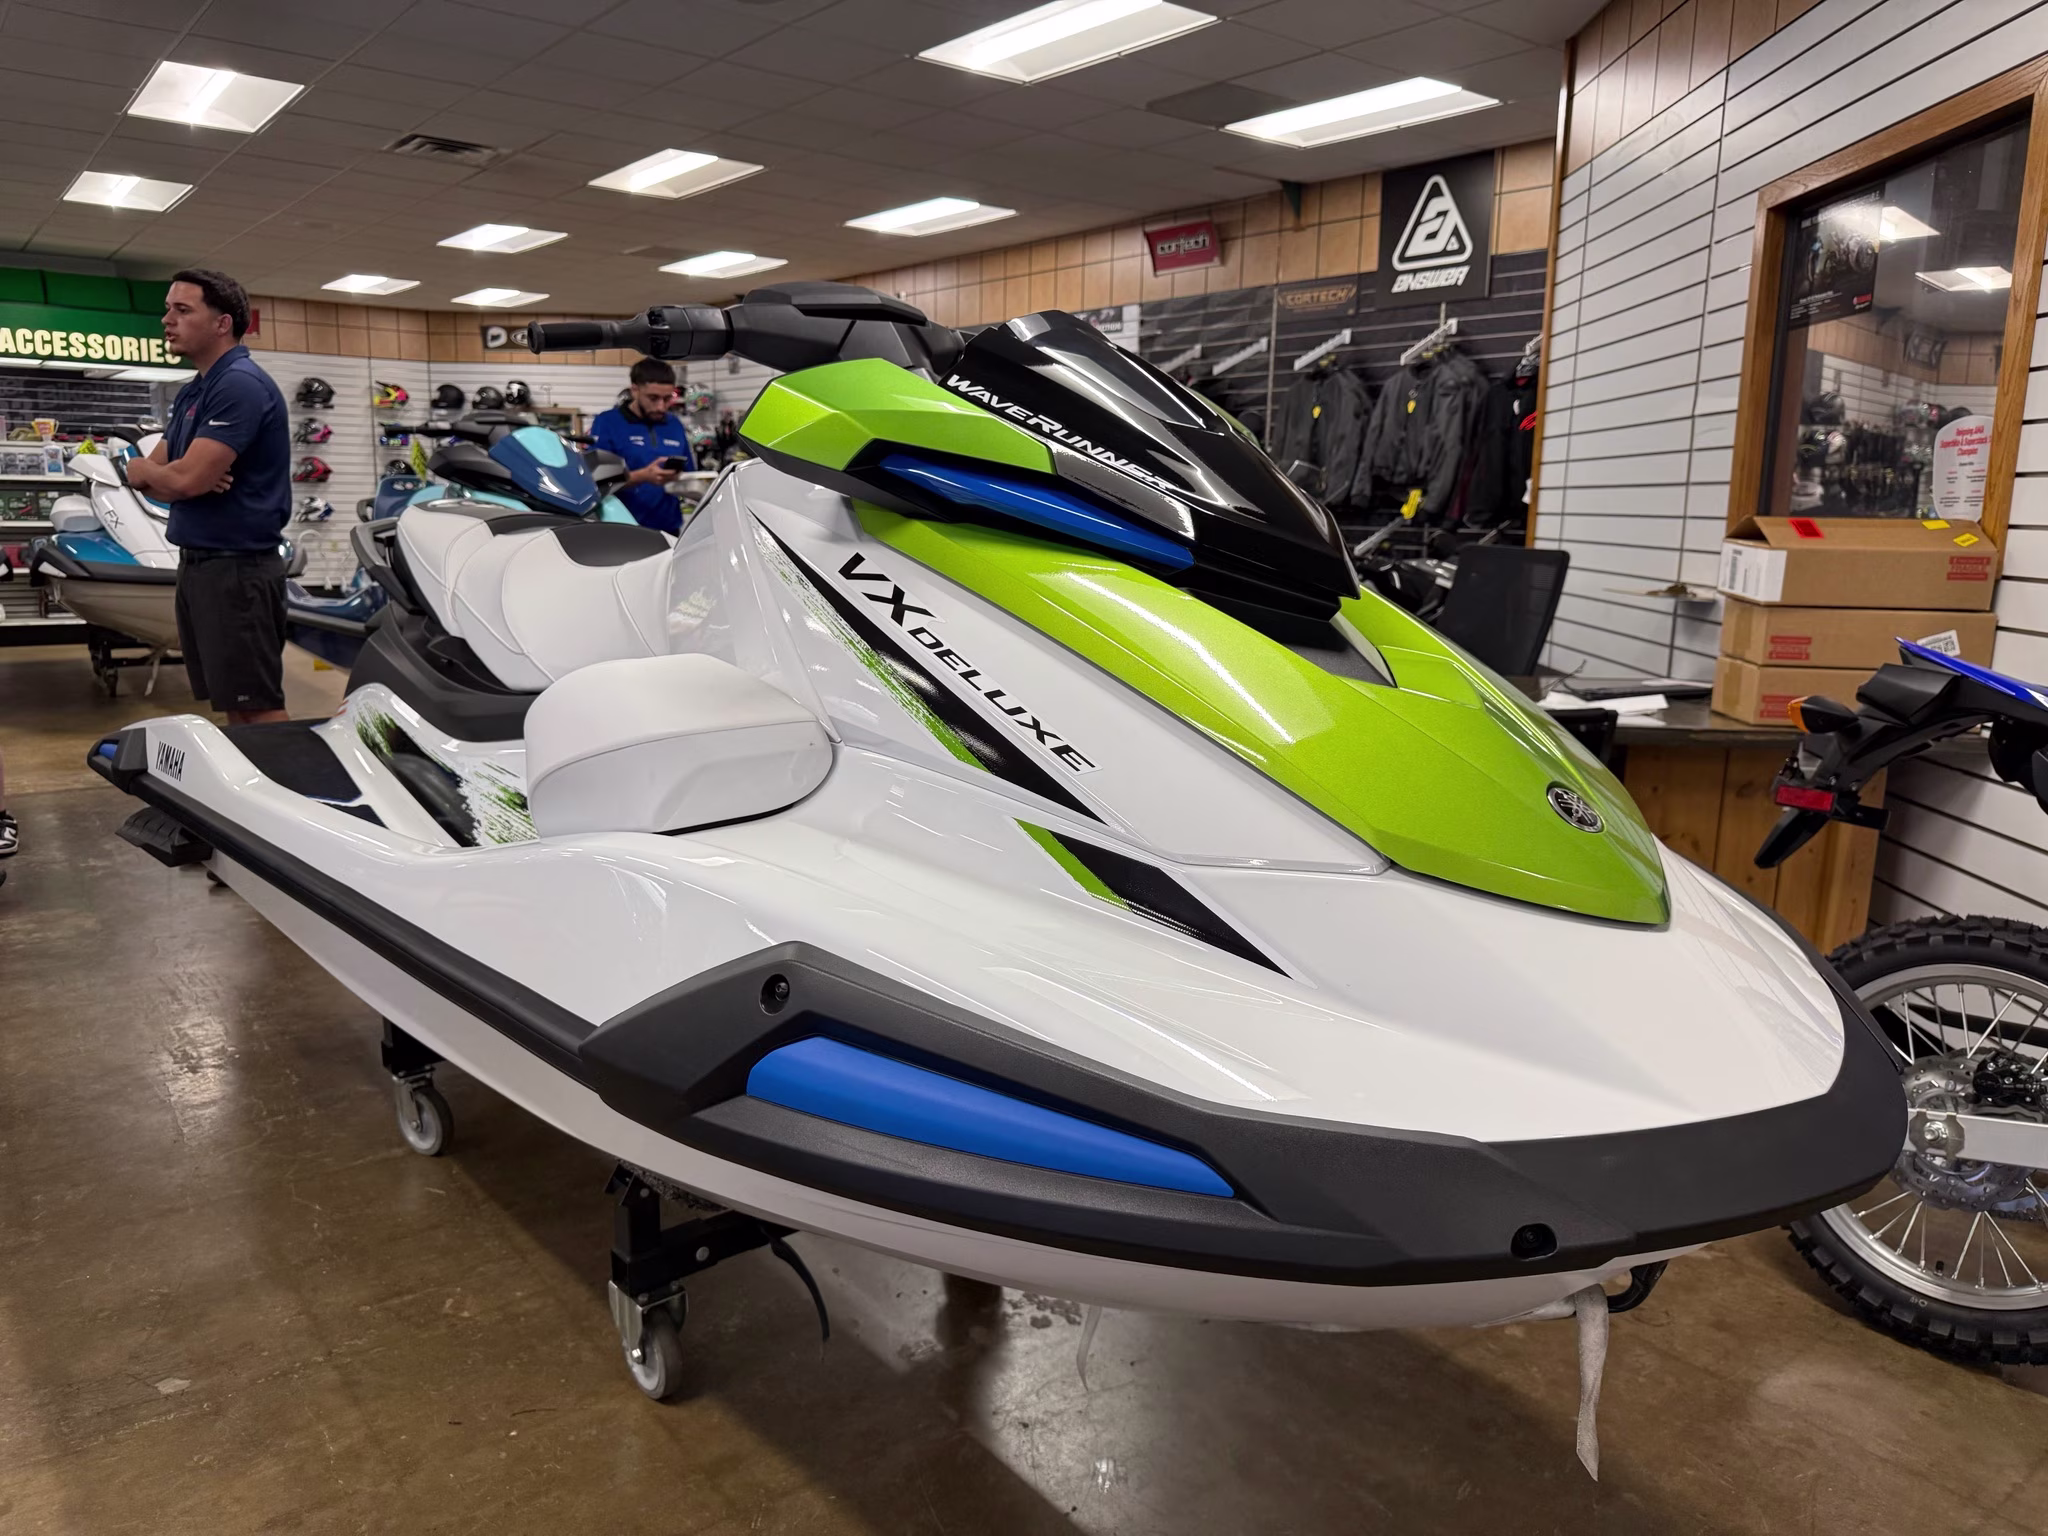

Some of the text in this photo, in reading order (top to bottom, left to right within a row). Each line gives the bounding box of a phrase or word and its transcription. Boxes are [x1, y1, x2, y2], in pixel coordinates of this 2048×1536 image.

[104, 509, 126, 530] FX
[838, 552, 1096, 772] VX DELUXE
[156, 741, 185, 781] YAMAHA
